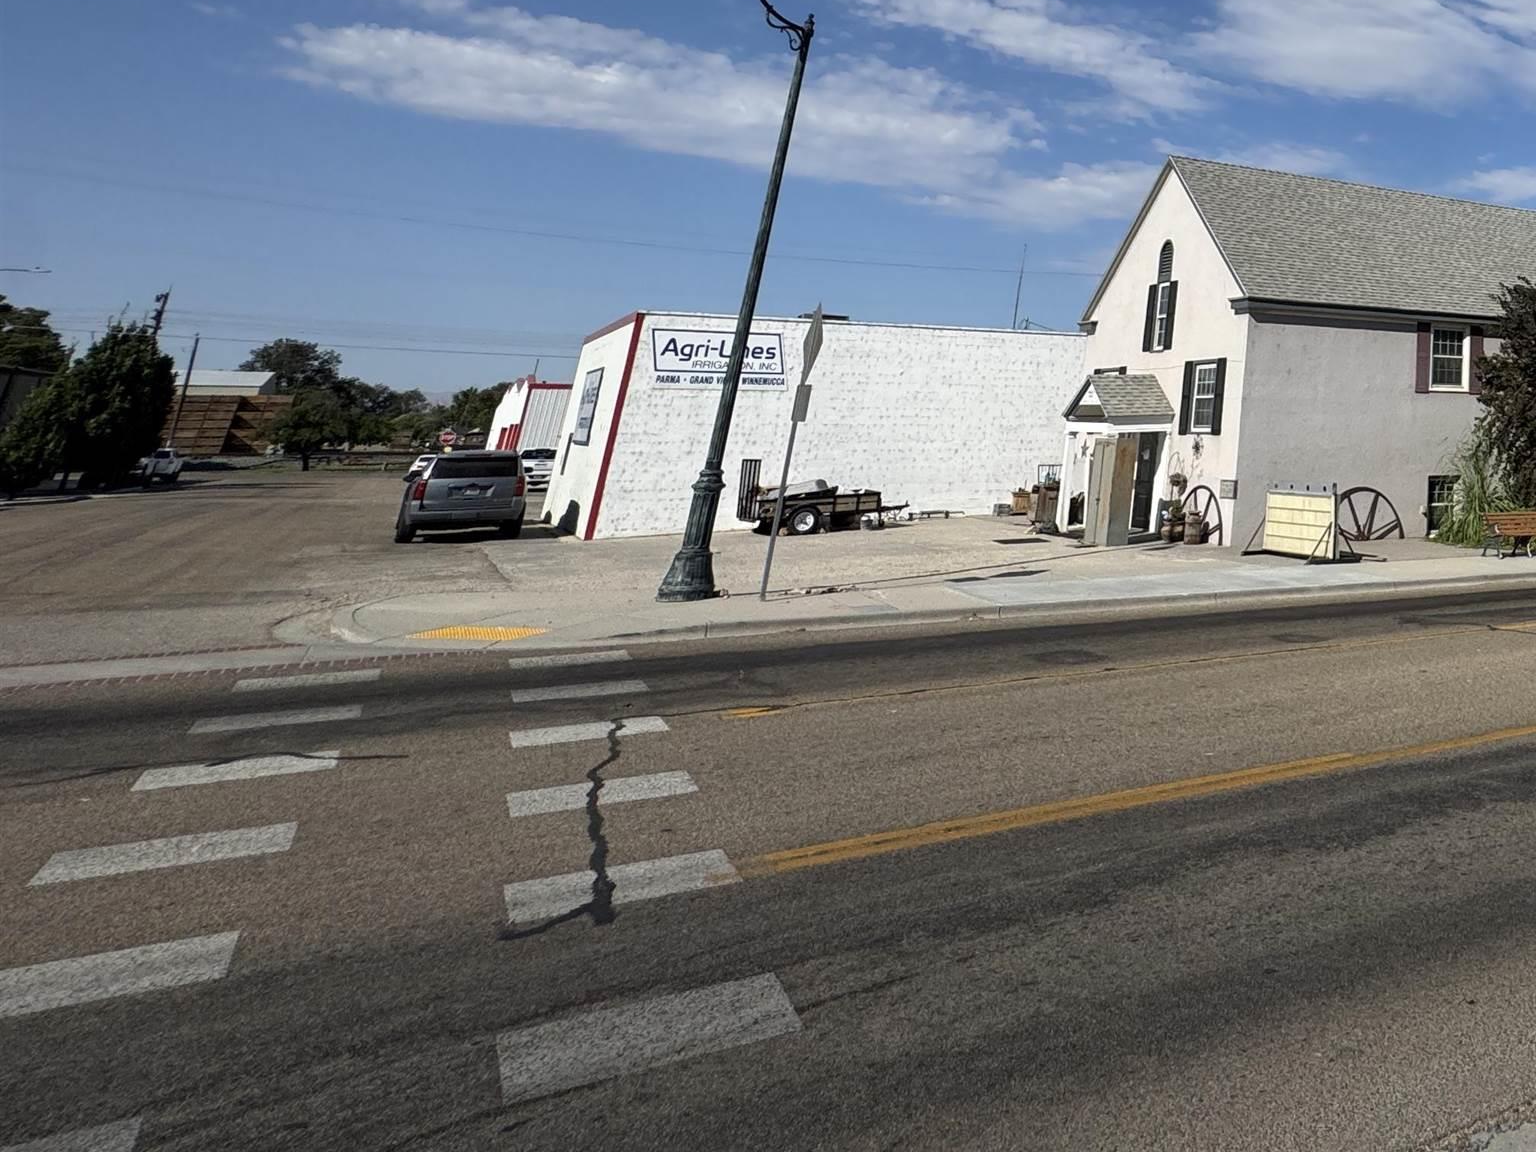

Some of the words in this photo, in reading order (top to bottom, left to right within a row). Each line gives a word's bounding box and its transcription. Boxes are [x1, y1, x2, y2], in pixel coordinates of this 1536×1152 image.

[660, 337, 777, 361] Agri-Lnes
[655, 374, 680, 384] PARMA
[689, 375, 714, 385] GRAND
[741, 377, 785, 386] WINNEMUCCA
